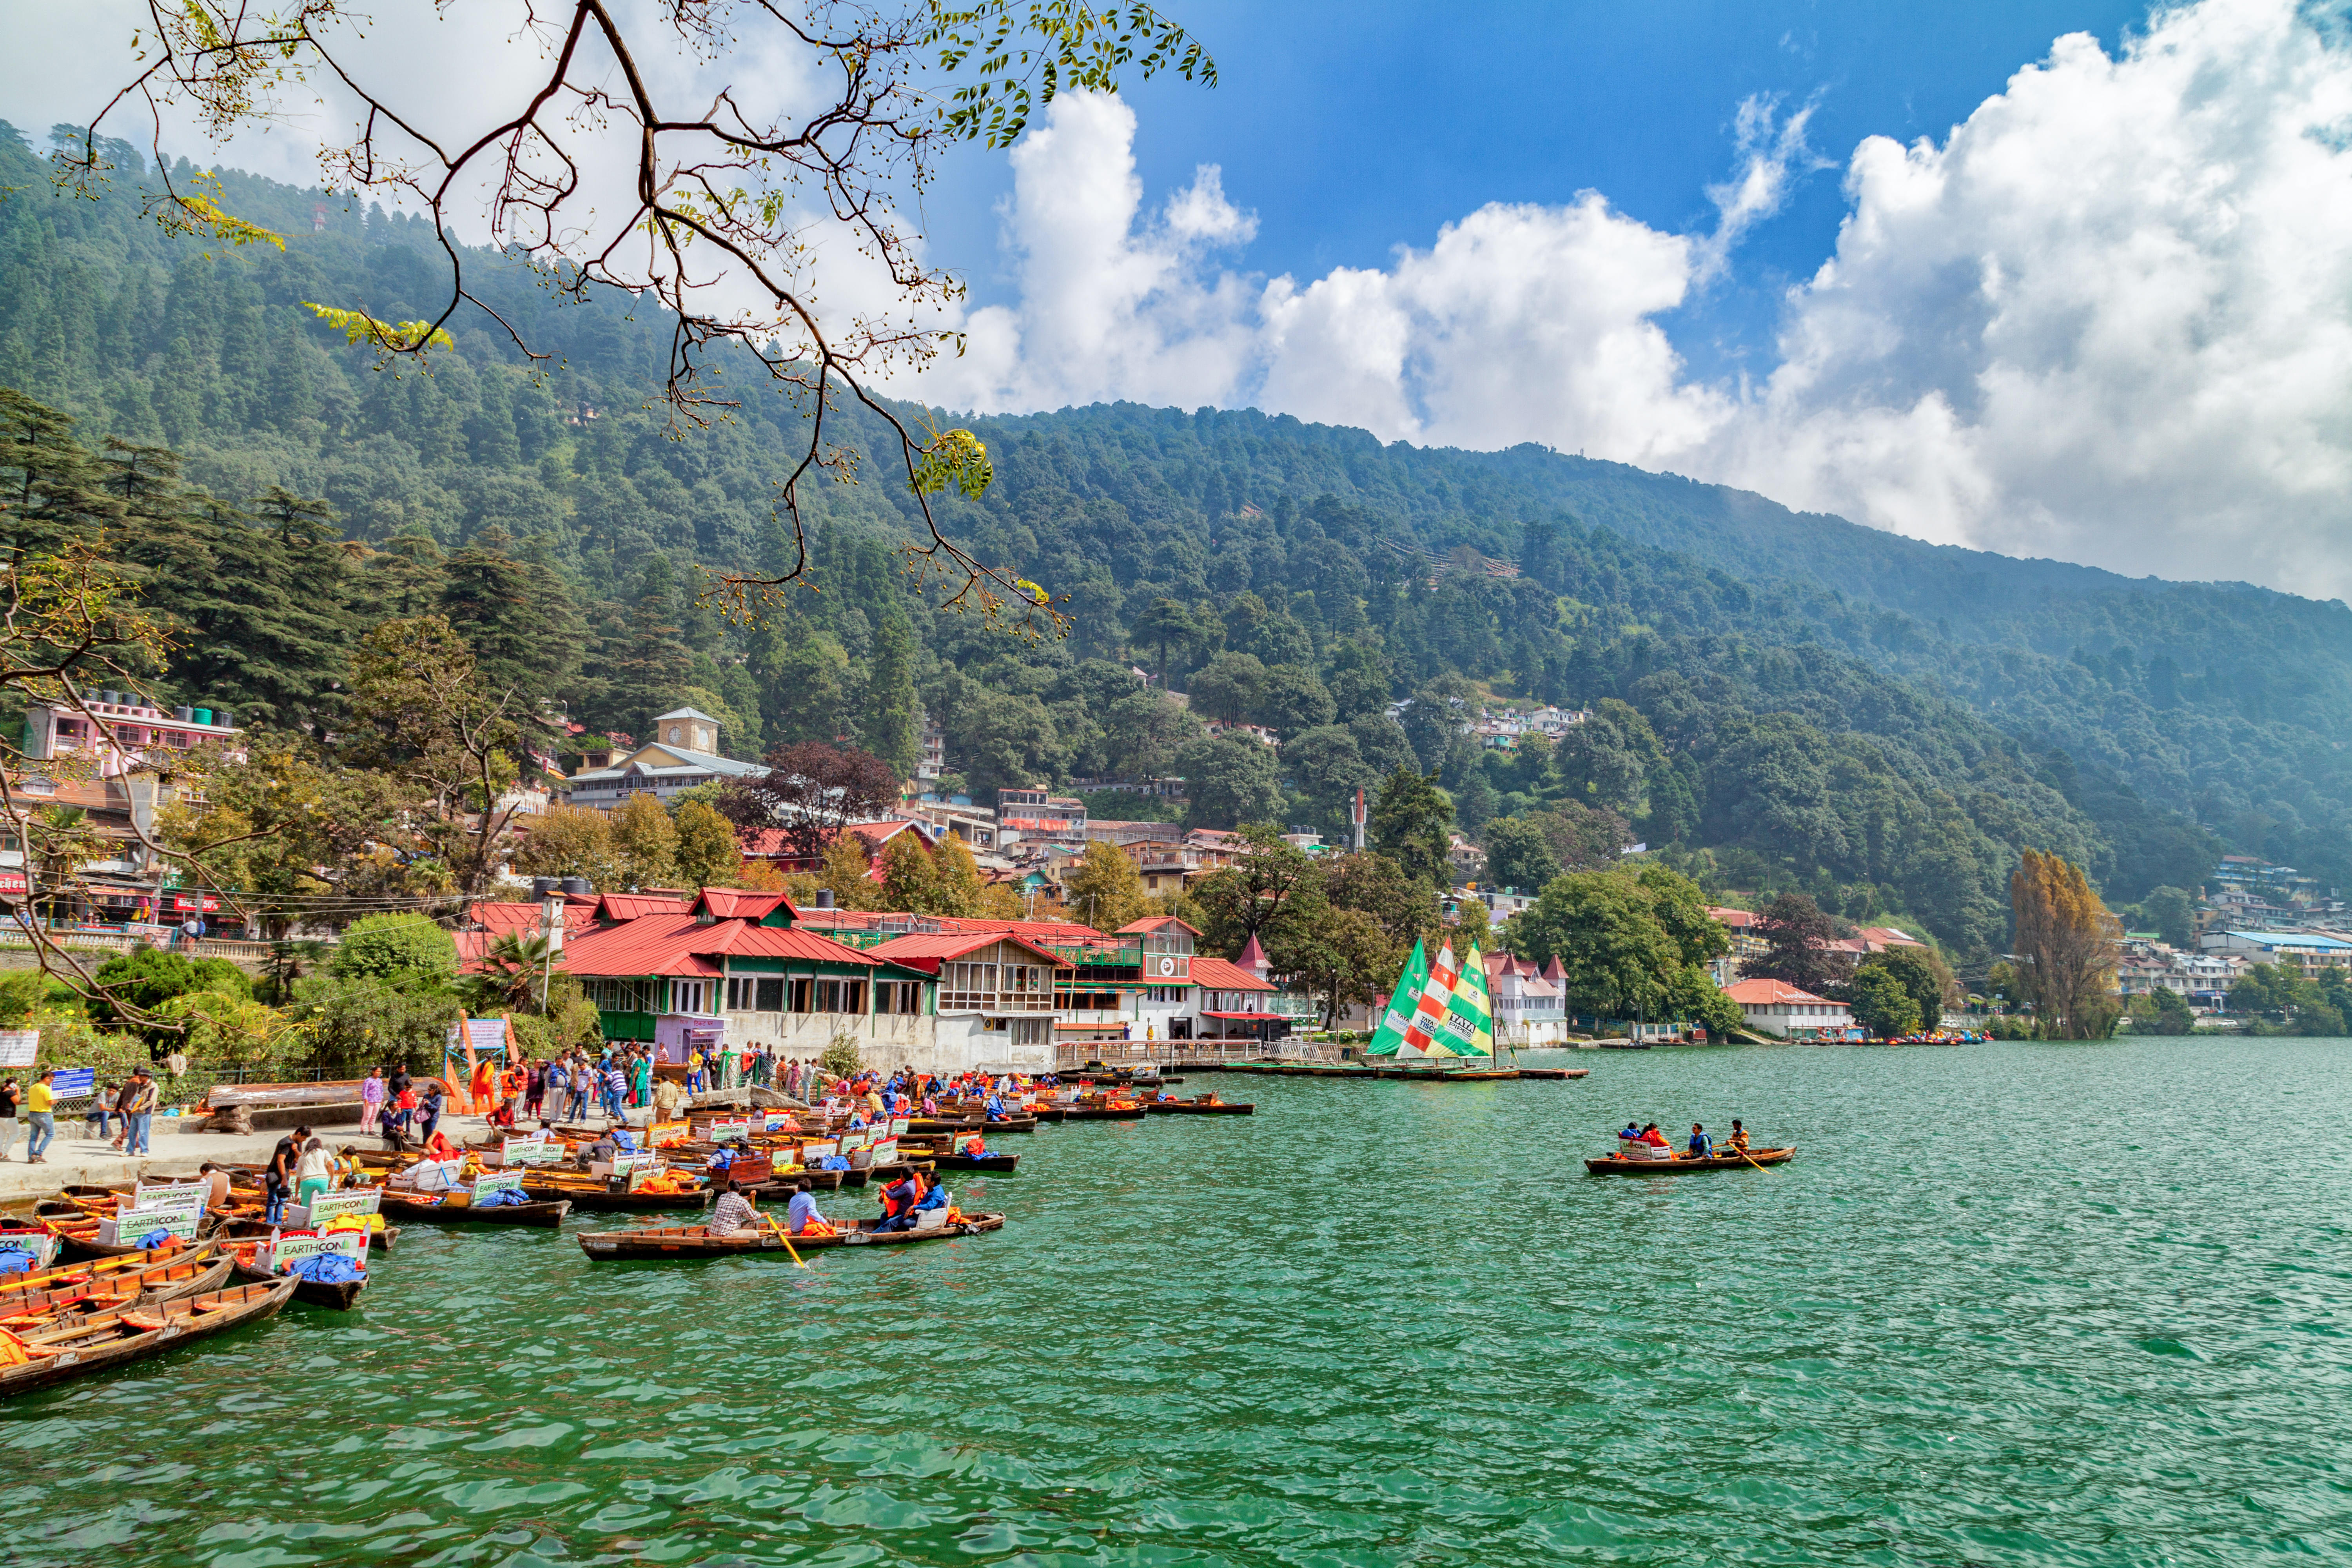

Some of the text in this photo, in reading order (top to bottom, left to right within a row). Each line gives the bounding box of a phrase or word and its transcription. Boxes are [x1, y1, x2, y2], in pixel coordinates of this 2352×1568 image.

[1398, 1013, 1409, 1022] TATA
[1422, 1016, 1434, 1025] TATA
[1452, 1013, 1475, 1033] TATA
[1449, 1022, 1471, 1038] PIPES
[654, 1128, 681, 1137] EARTHCON
[510, 1145, 536, 1154] EARTHCON
[636, 1171, 659, 1181] EARTHCON
[479, 1181, 511, 1192] EARTHCON
[318, 1200, 363, 1213] EARTHCON
[127, 1216, 181, 1229] EARTHCON
[284, 1242, 342, 1255] EARTHCON
